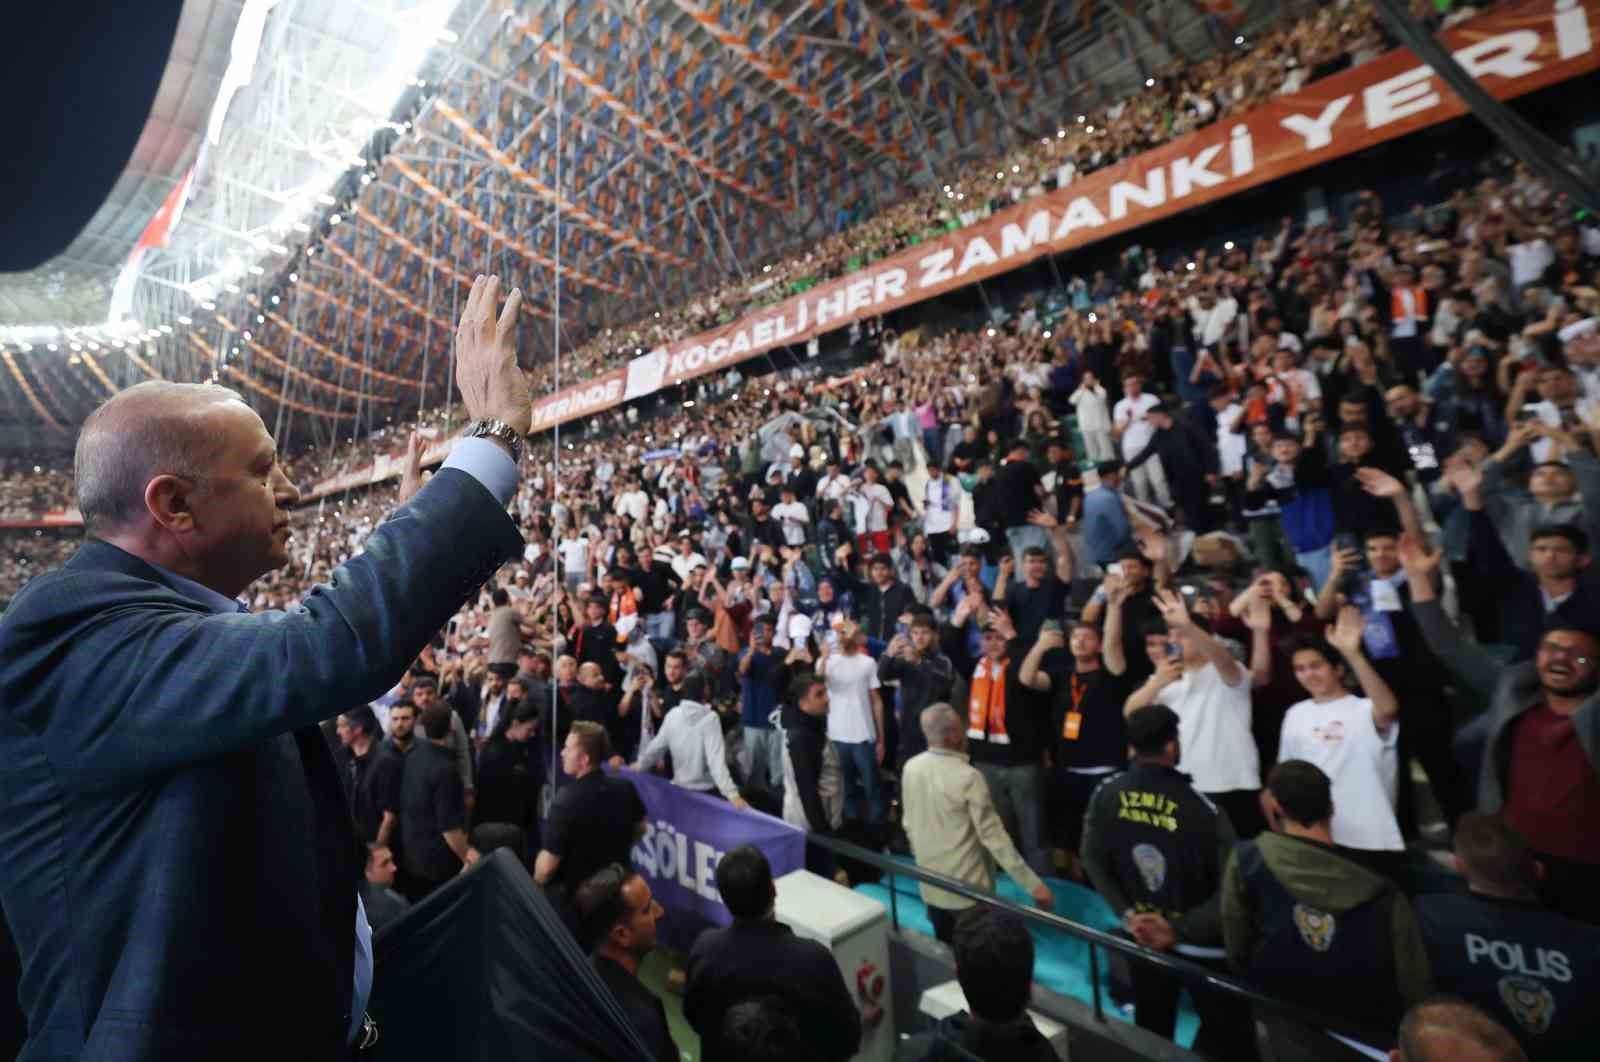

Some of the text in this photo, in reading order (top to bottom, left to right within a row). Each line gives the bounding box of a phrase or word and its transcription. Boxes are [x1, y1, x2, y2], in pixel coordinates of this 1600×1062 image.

[816, 267, 908, 325] HER
[918, 123, 1255, 288] ZAMANKİ
[1279, 0, 1592, 151] YERİ
